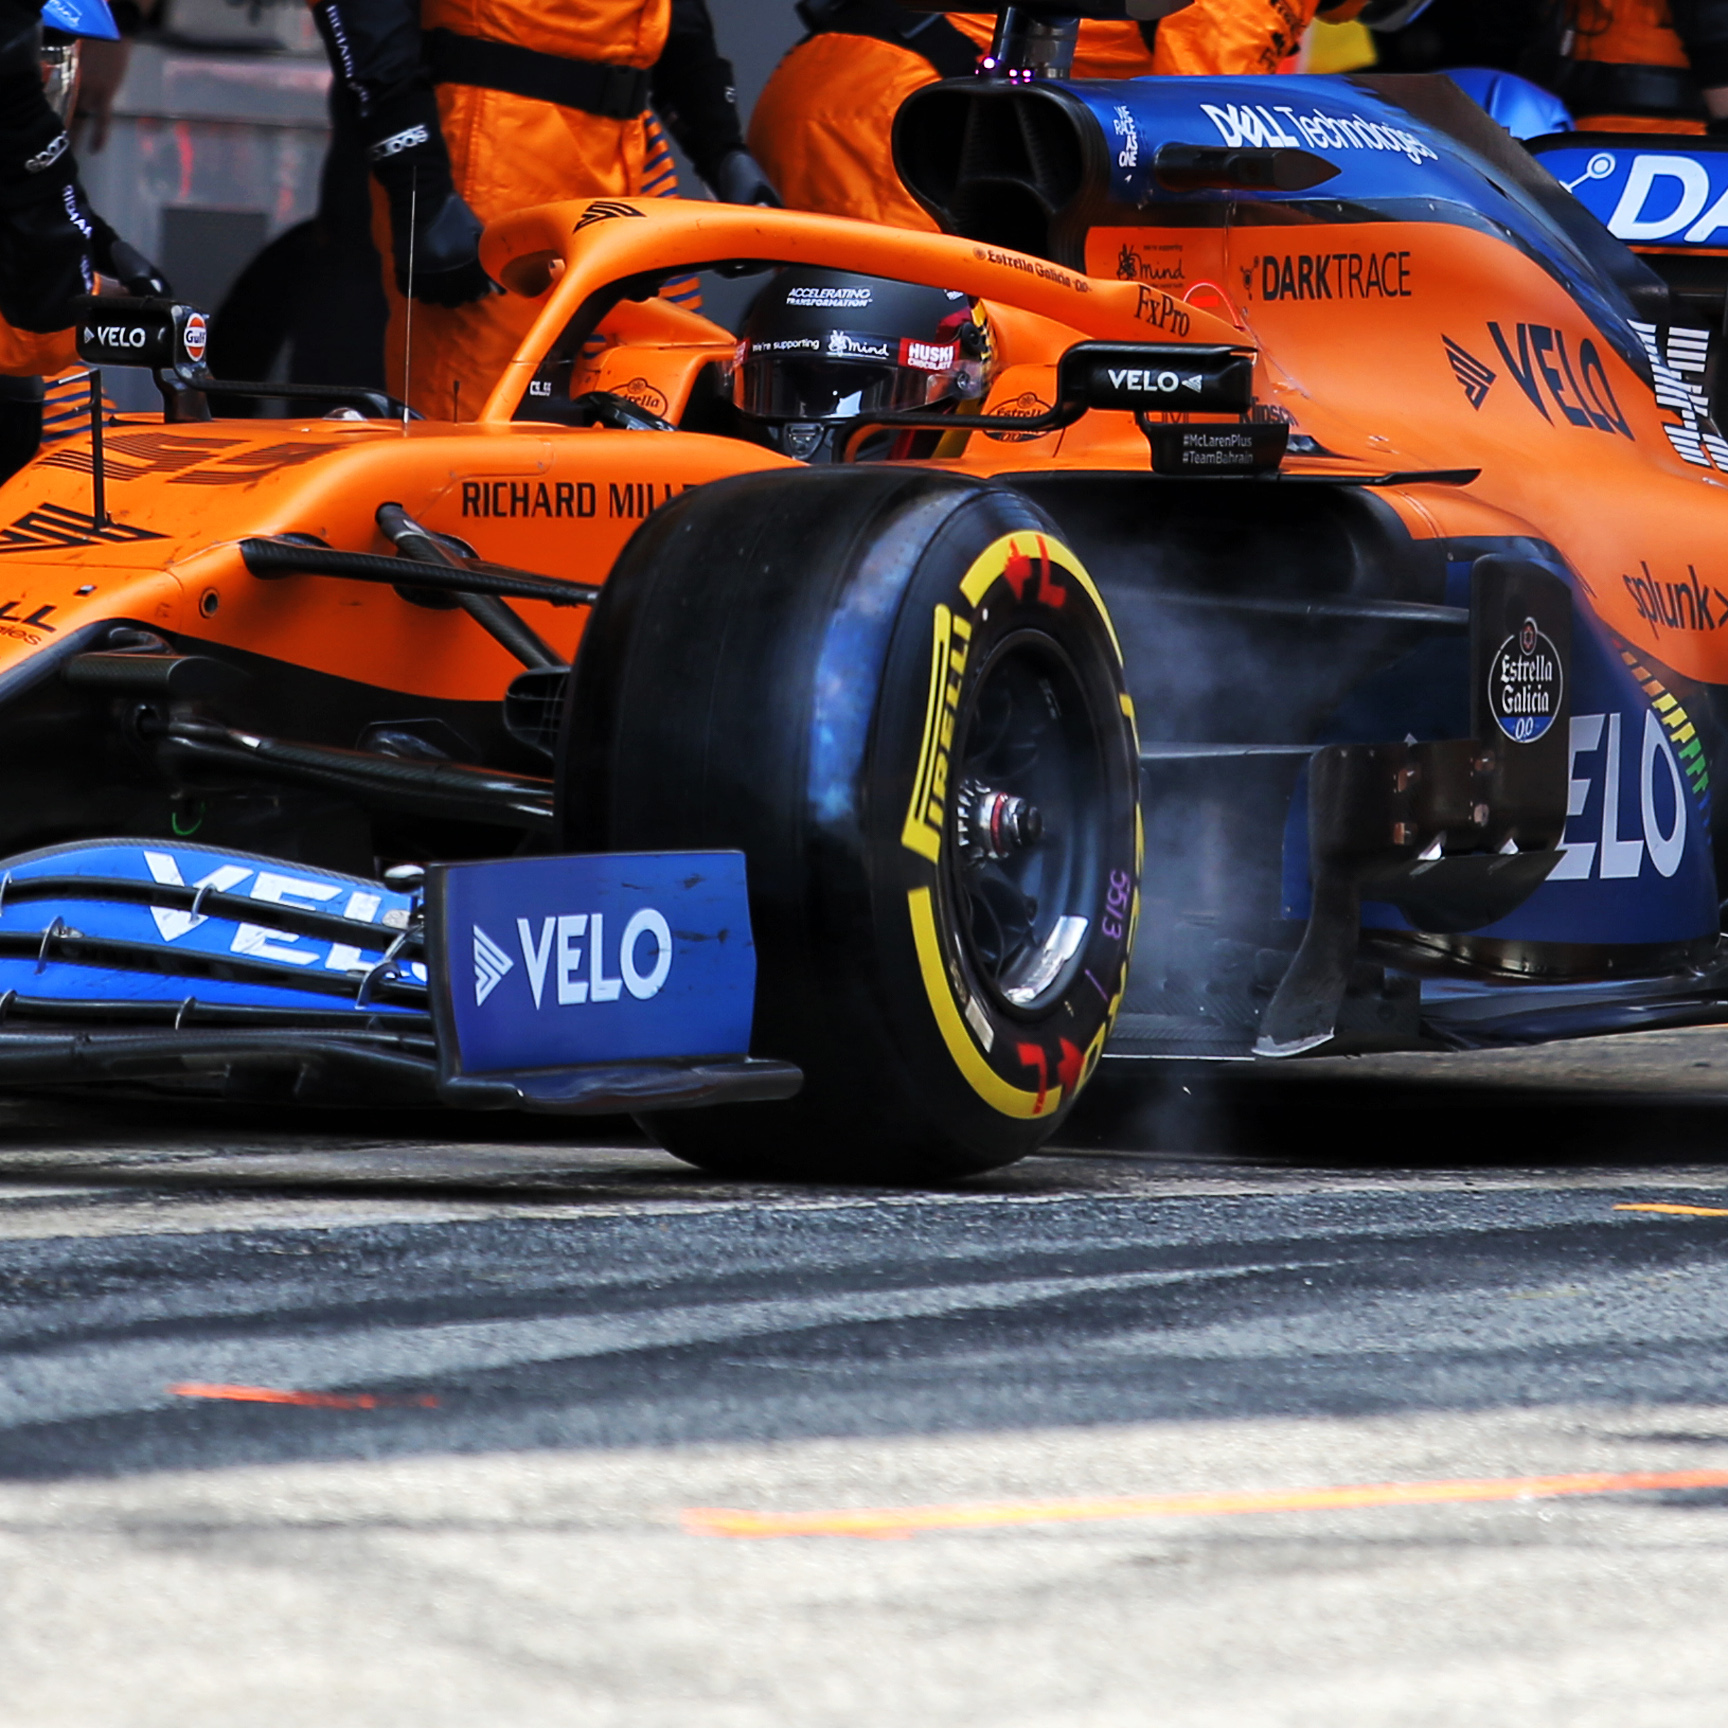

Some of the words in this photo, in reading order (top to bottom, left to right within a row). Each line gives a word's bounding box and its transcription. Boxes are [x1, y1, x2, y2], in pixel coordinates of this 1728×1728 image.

[1200, 103, 1297, 149] DELL
[1285, 107, 1439, 166] Technologies
[1119, 150, 1138, 168] ONE
[986, 248, 1035, 274] Estrella
[1259, 250, 1412, 301] DARKTRACE
[1133, 283, 1191, 337] FxPro
[97, 326, 146, 349] VELO
[185, 329, 207, 346] Gulf
[773, 337, 820, 353] supporting
[907, 342, 954, 363] HUSKI
[1107, 369, 1180, 393] VELO
[1486, 320, 1636, 442] VELO
[1182, 433, 1253, 449] #McLarenPlus
[1182, 449, 1254, 466] #TeamBahrain
[462, 480, 596, 520] RICHARD
[608, 482, 696, 520] MILL
[1499, 654, 1554, 684] Estrella
[1501, 685, 1550, 715] Galicia
[900, 603, 972, 866] PIRELLI
[1546, 709, 1687, 880] ELO
[141, 848, 428, 983] VEL
[517, 907, 674, 1010] VELO
